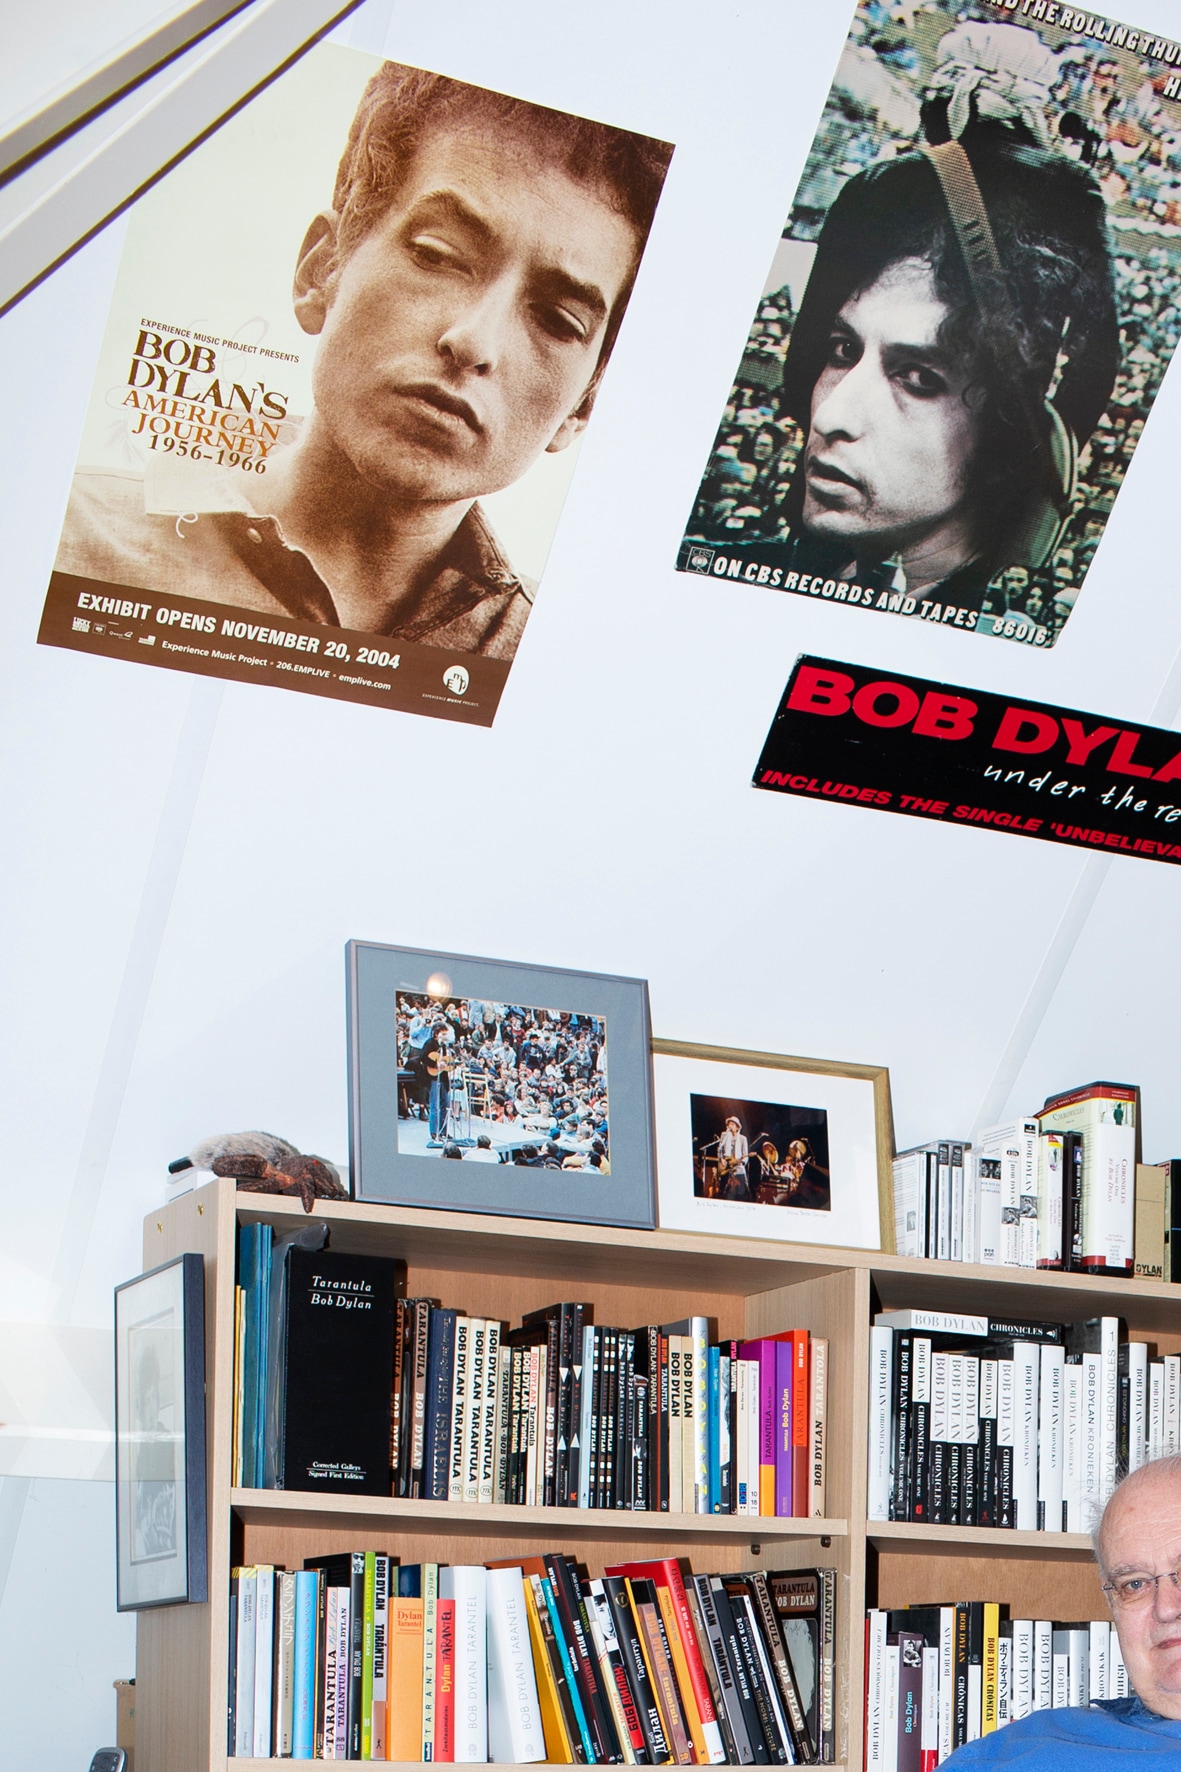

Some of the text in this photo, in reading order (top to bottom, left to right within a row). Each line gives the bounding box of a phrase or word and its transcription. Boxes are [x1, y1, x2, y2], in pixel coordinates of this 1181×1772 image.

[1020, 2, 1056, 24] THE
[1060, 9, 1140, 51] ROLLING
[133, 329, 217, 374] BOB
[140, 318, 300, 364] EXPERIENCE MUSIC PROJECT PRESENTS
[127, 358, 289, 420] DYLAN'S
[121, 389, 282, 441] AMERICAN
[131, 412, 277, 458] JOURNEY
[148, 434, 267, 475] 1956-1966
[712, 555, 1048, 647] ON CBS RECORDS AND TAPES 86016
[77, 591, 401, 669] EXHIBIT OPENS NOVEMBER 20, 2004
[161, 640, 391, 691] Experience Music Project 206.EMPLIVE emplive.com
[786, 665, 979, 742] BOB
[760, 769, 890, 806] INCLUDES
[899, 793, 950, 816] THE
[952, 804, 1043, 834] SINGLE
[983, 762, 1086, 800] under
[1100, 785, 1145, 813] the
[311, 1275, 373, 1292] Tarantula
[1135, 1263, 1163, 1275] DYLAN
[310, 1293, 372, 1310] Bob Dylan
[914, 1314, 1044, 1336] BOB DYLAN CHRONICLES
[452, 1326, 467, 1478] BOB DYLAN TARANTULA
[934, 1357, 946, 1508] BOB DYLAN CHRONICLES
[397, 1610, 423, 1621] Dylan
[440, 1608, 453, 1694] Dylan TARANTEL
[1018, 1633, 1029, 1720] BOB DYLAN
[325, 1649, 337, 1748] TARANTULA
[905, 1691, 913, 1734] Bob Dylan
